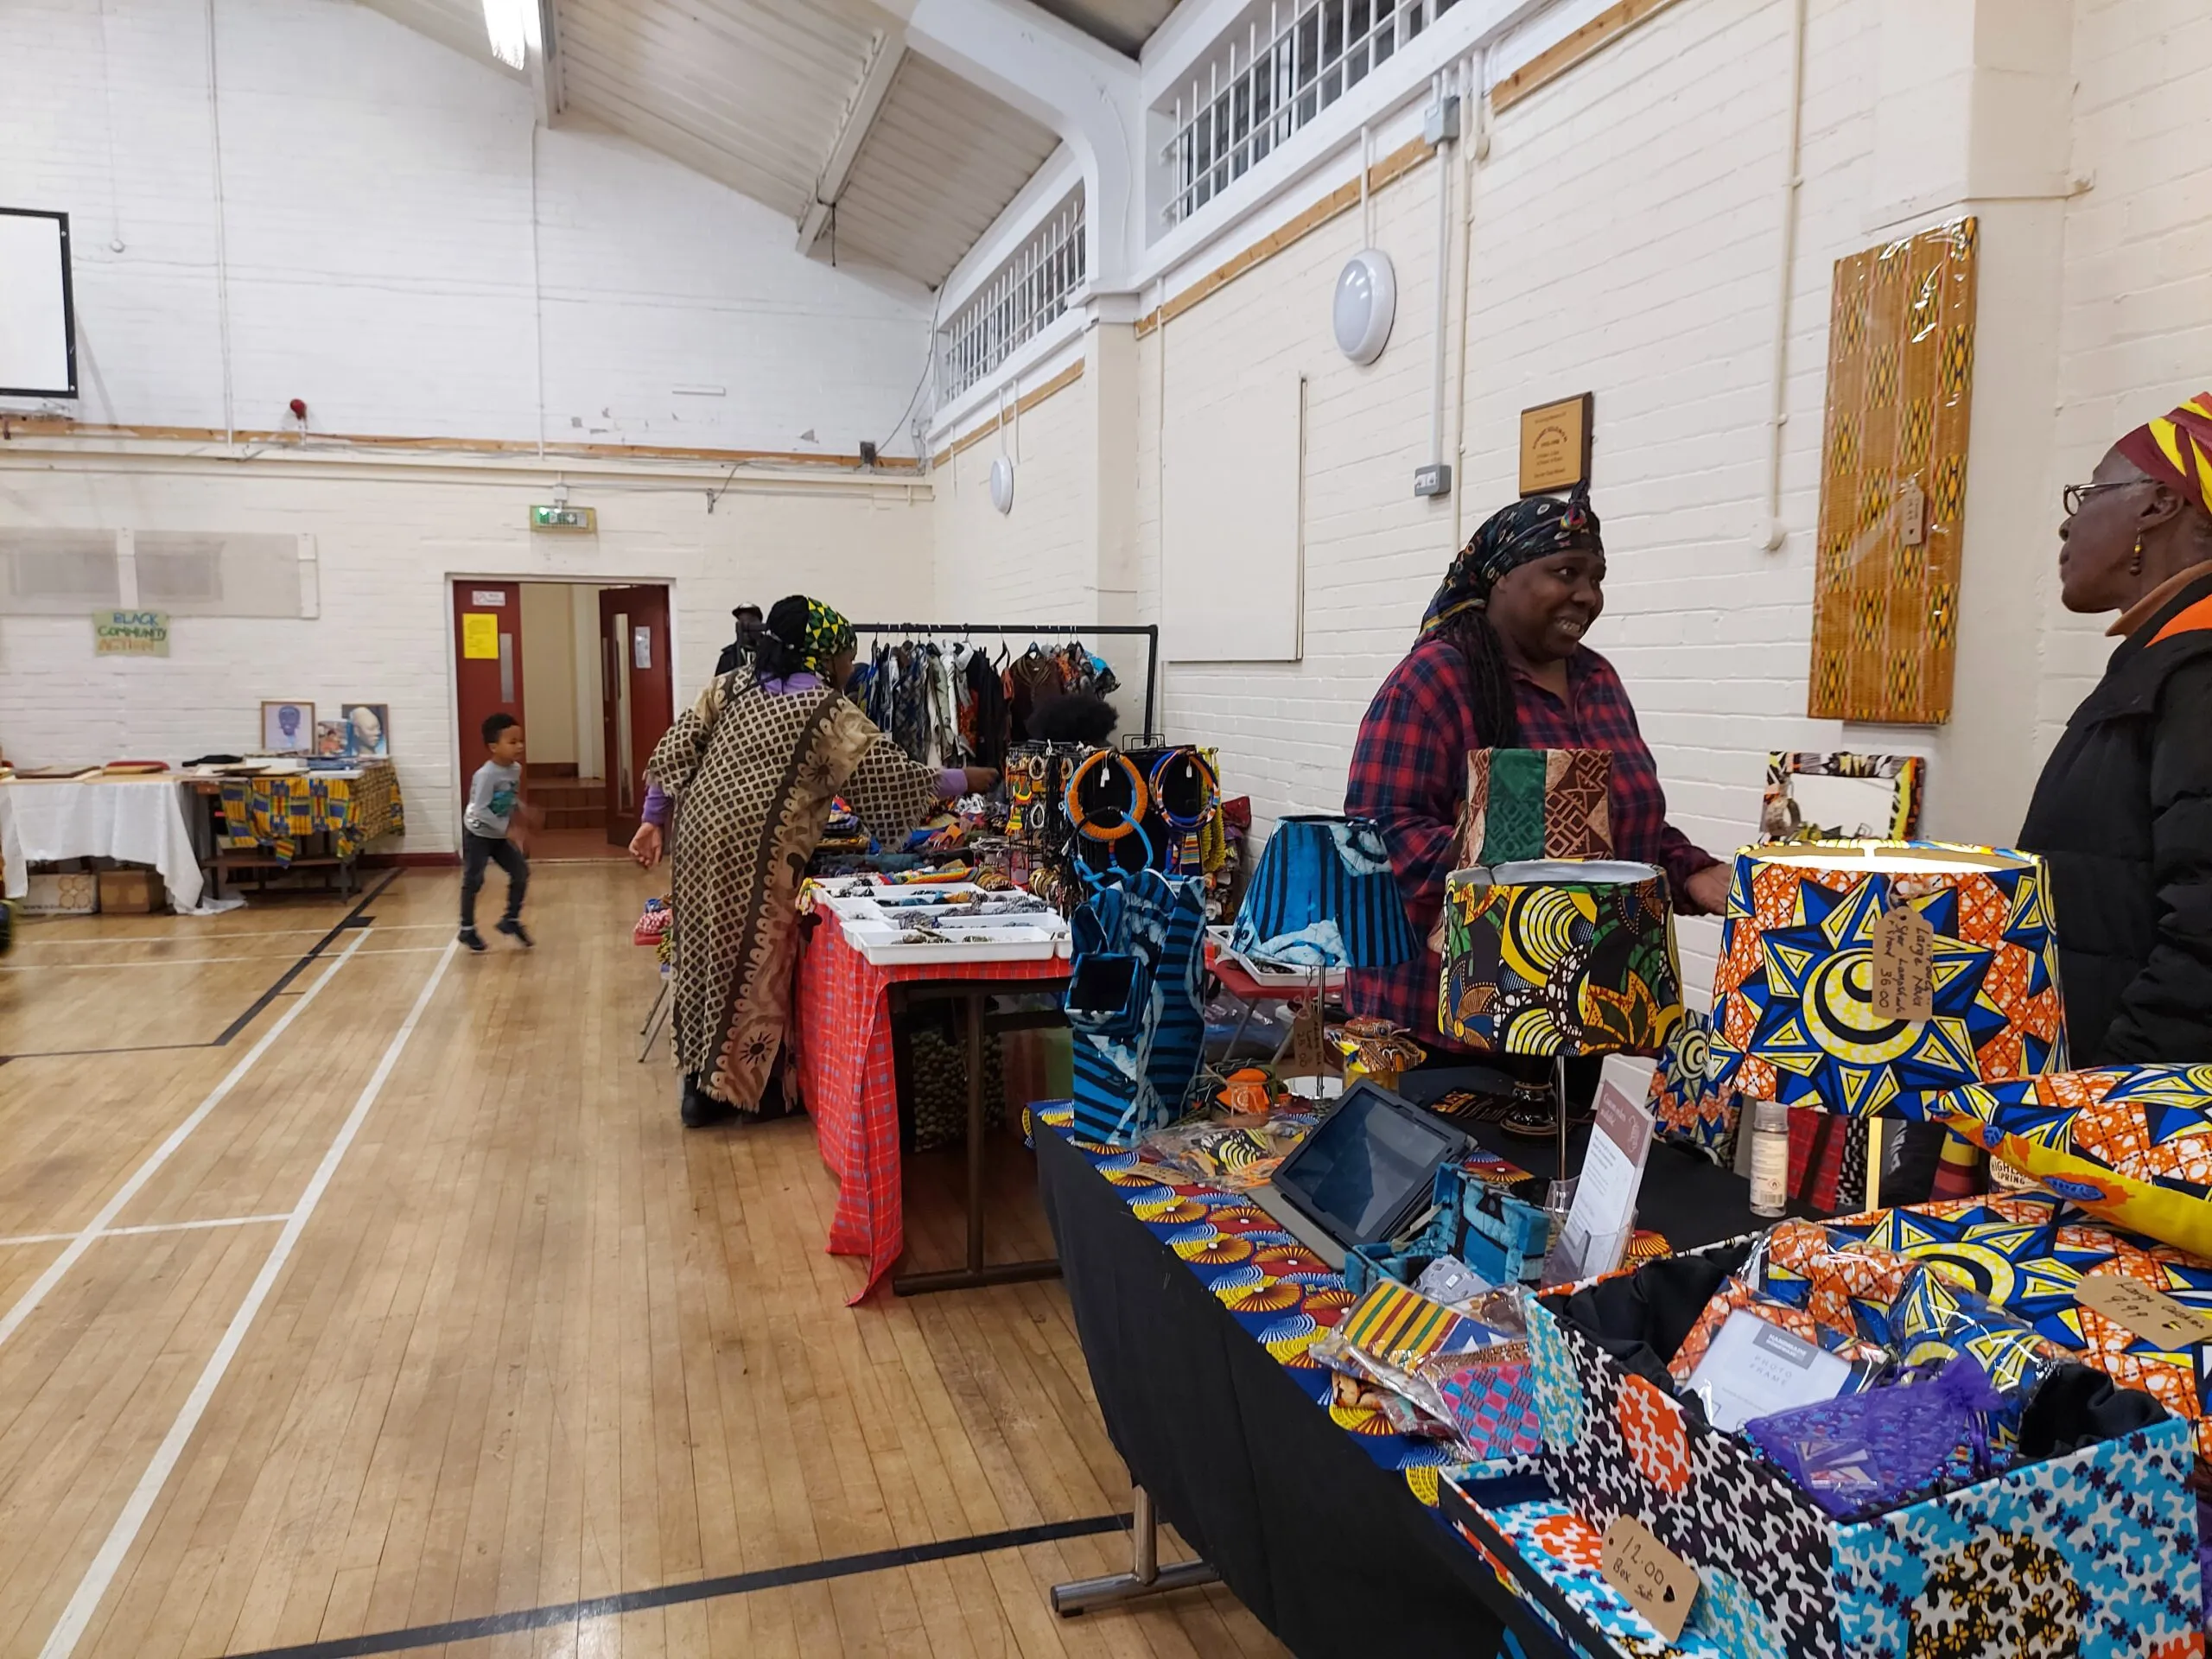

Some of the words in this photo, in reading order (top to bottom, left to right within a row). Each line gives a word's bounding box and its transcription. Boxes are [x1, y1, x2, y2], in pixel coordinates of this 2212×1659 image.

[113, 612, 158, 626] BLACK
[1910, 927, 1929, 966] Large
[1991, 1160, 2024, 1176] HIGHL
[1997, 1171, 2025, 1185] SPRING
[1750, 1363, 1787, 1387] FRAME
[1754, 1354, 1792, 1378] PHOTO
[1613, 1557, 1631, 1584] Box
[1622, 1535, 1664, 1586] 12.00
